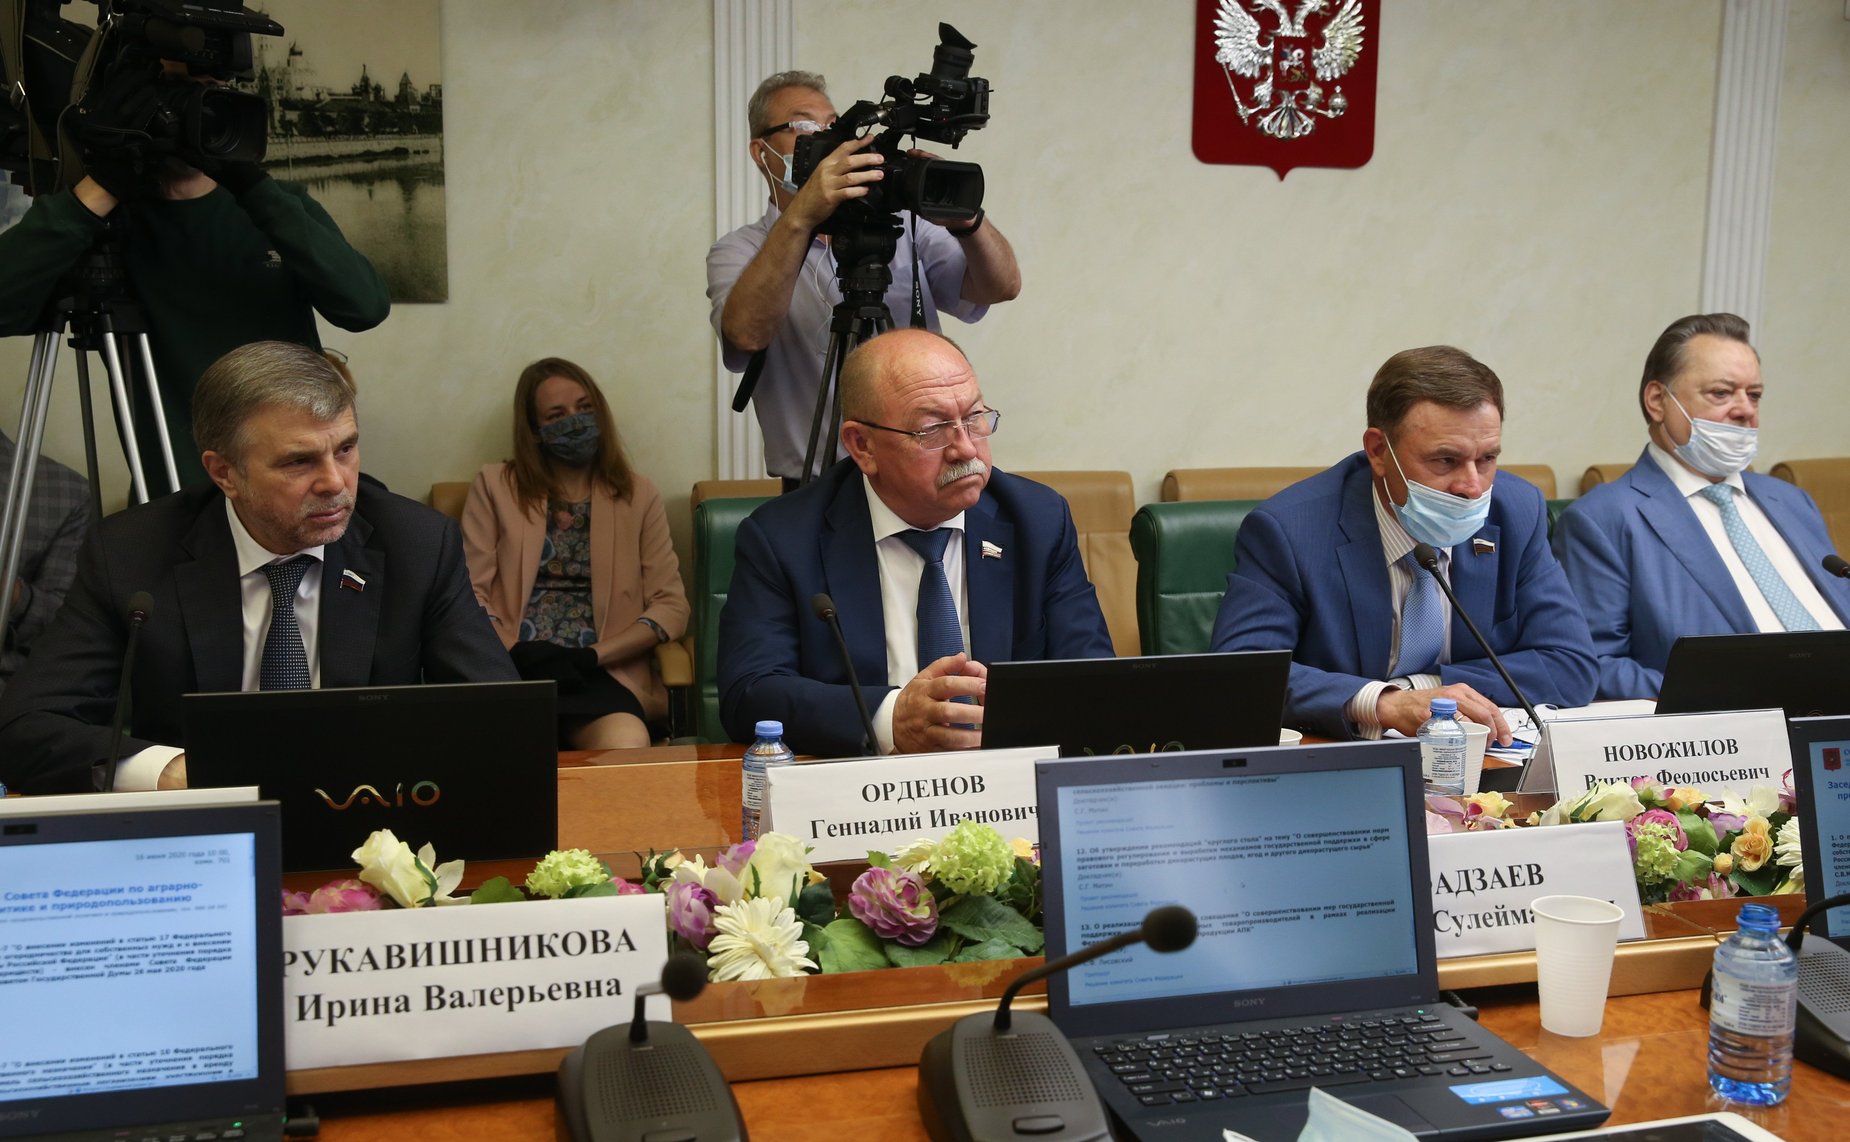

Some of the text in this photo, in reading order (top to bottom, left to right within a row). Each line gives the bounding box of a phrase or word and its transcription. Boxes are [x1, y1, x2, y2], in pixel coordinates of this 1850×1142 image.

[914, 281, 922, 317] SONY
[1604, 738, 1738, 762] НОВОЖИЛОВ
[862, 775, 985, 803] ОРДЕНОВ
[1657, 767, 1769, 786] Феодосьевич
[315, 781, 441, 811] VAIO
[810, 811, 921, 839] Геннадий
[4, 881, 203, 902] Совета Федерации по аграрно-
[1431, 863, 1544, 898] АДЗАЕВ
[52, 894, 192, 912] природопользованию
[282, 928, 637, 977] РУКАВИШНИКОВА
[296, 976, 622, 1027] Ирина Валерьевна
[1234, 998, 1265, 1008] SONY
[1147, 1117, 1186, 1127] VAIO
